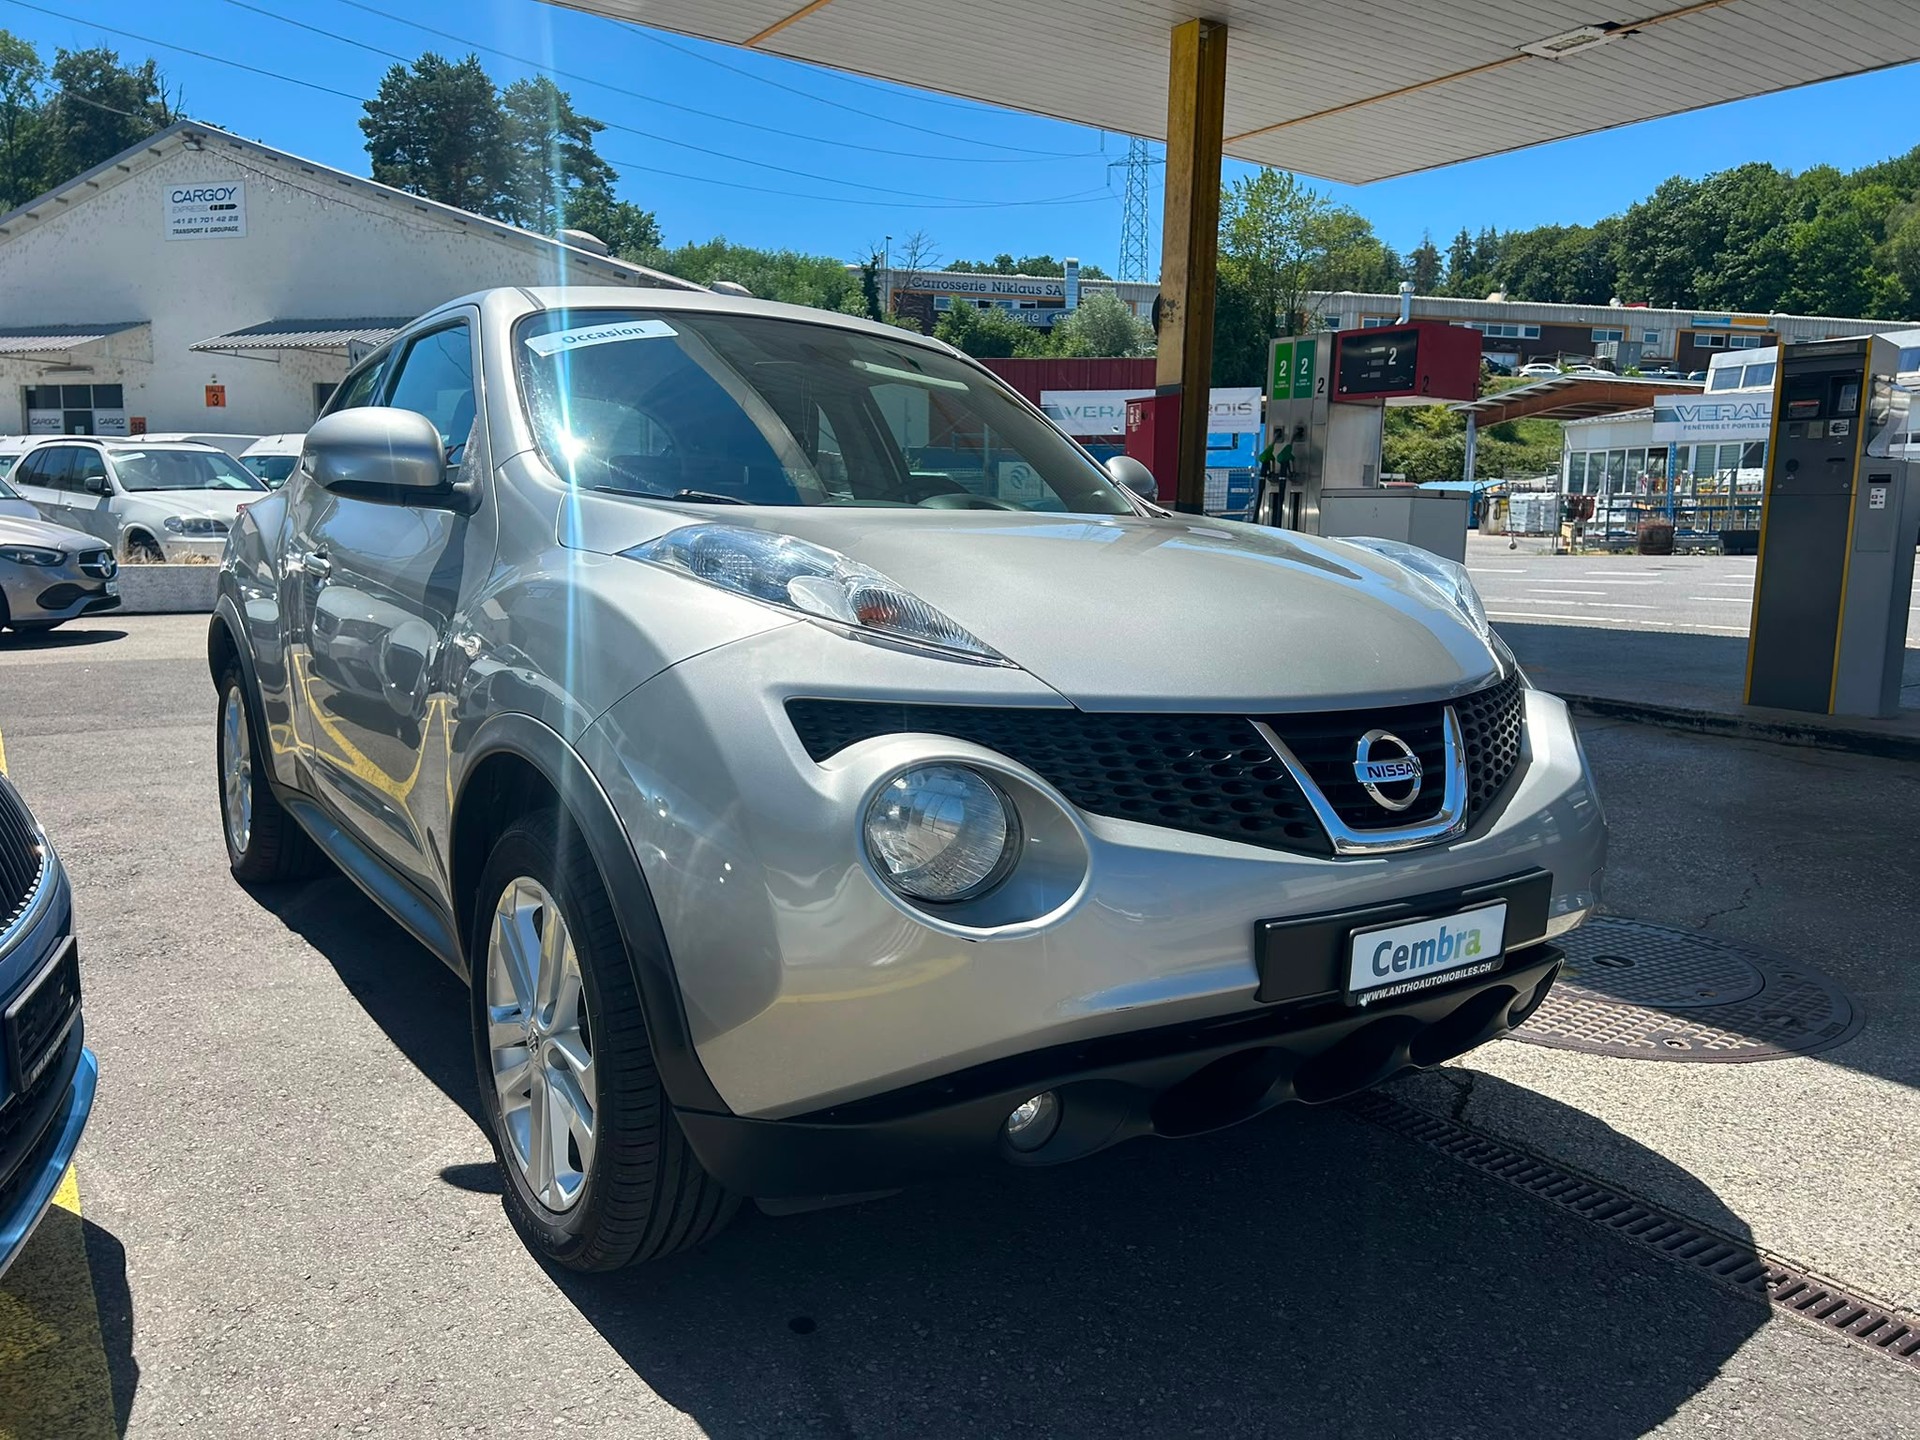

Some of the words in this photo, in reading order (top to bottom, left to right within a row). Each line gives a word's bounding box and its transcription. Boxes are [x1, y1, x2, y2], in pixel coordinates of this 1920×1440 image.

[172, 187, 237, 203] CARGOY
[172, 227, 203, 235] TRANSPORT
[912, 277, 986, 292] Carrosserie
[991, 281, 1042, 295] Niklaus
[1045, 285, 1063, 296] SA
[562, 326, 645, 344] Occasion
[1388, 347, 1397, 365] 2
[1279, 360, 1287, 377] 2
[1300, 357, 1309, 375] 2
[1317, 377, 1325, 393] 2
[1422, 375, 1430, 393] 2
[212, 393, 219, 406] 3
[1366, 757, 1421, 778] NISSAN
[1372, 925, 1481, 977] Cembra
[1362, 962, 1492, 1003] WWW.ANTHOAUTOMOBILES.CH
